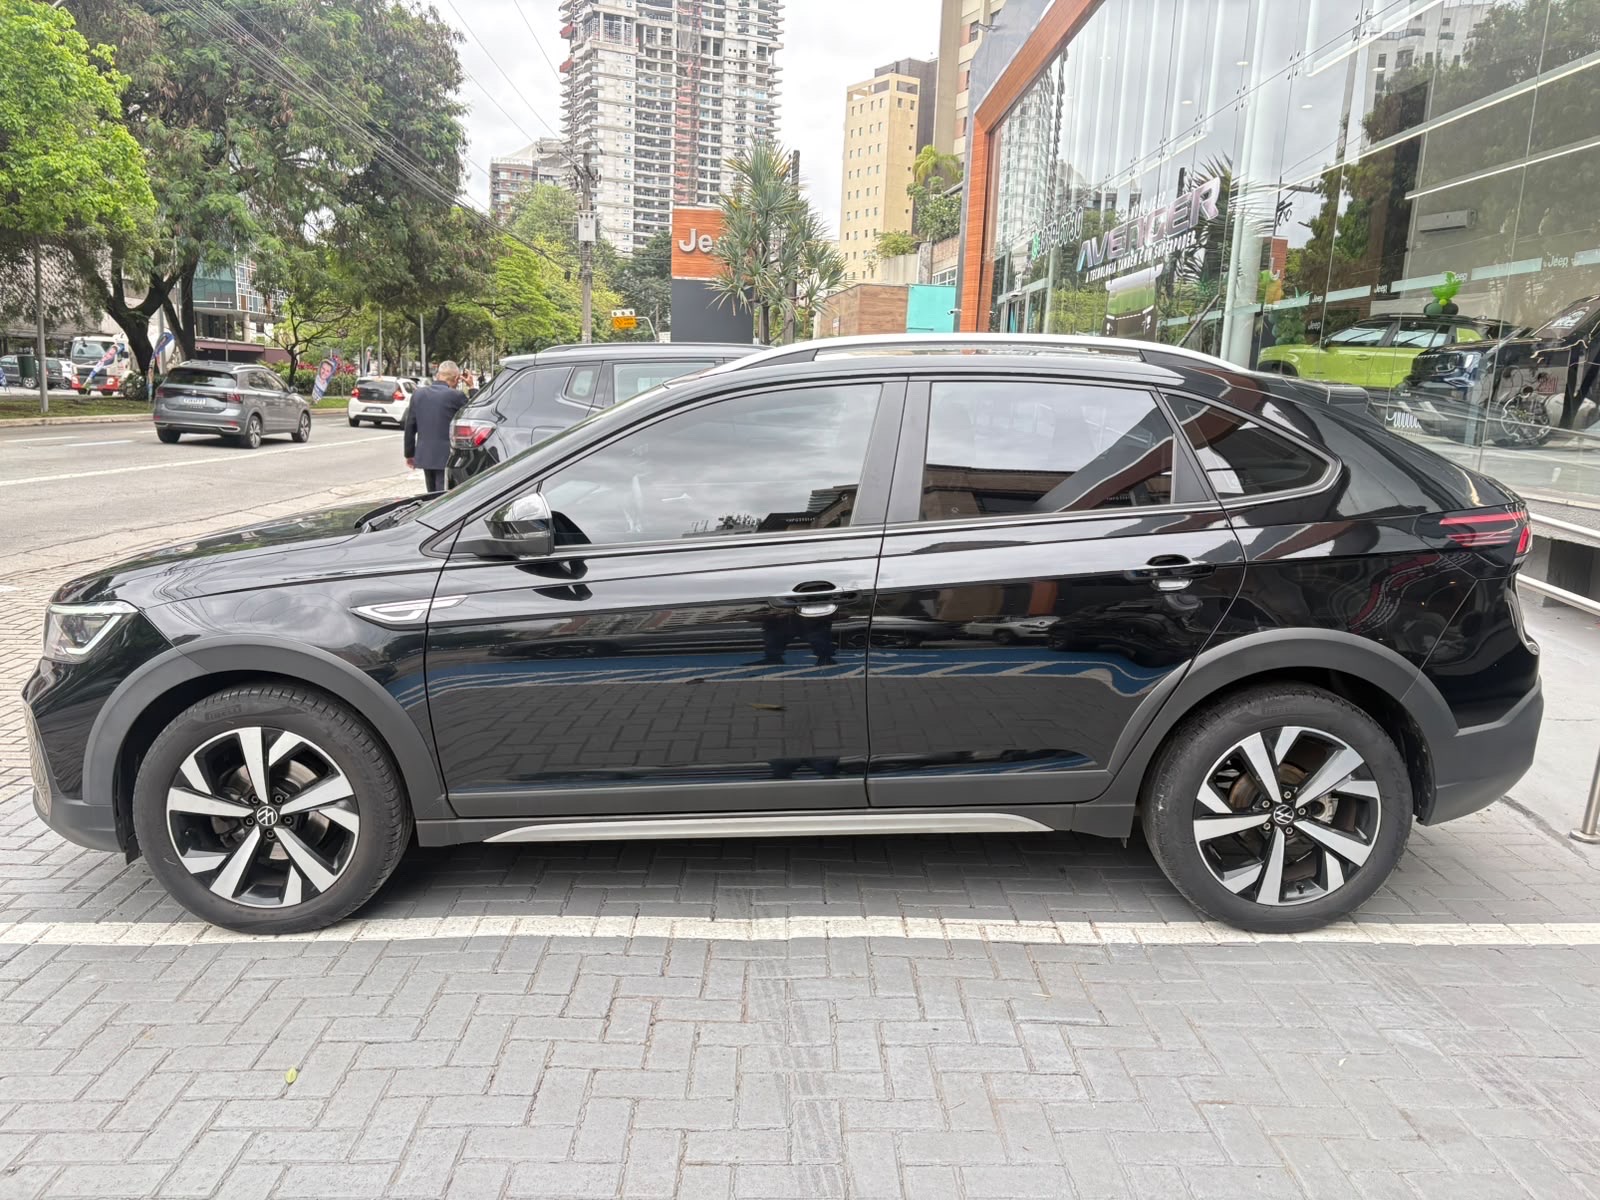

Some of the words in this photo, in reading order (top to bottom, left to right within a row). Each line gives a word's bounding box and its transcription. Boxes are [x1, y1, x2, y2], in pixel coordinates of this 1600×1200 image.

[1076, 176, 1220, 272] AVENGER
[678, 228, 714, 253] Je
[1548, 255, 1568, 268] Jeep
[1090, 260, 1117, 281] TECNOLOGIA
[1455, 272, 1468, 283] eep
[1376, 283, 1387, 293] Jeep
[1312, 294, 1324, 304] Jeep
